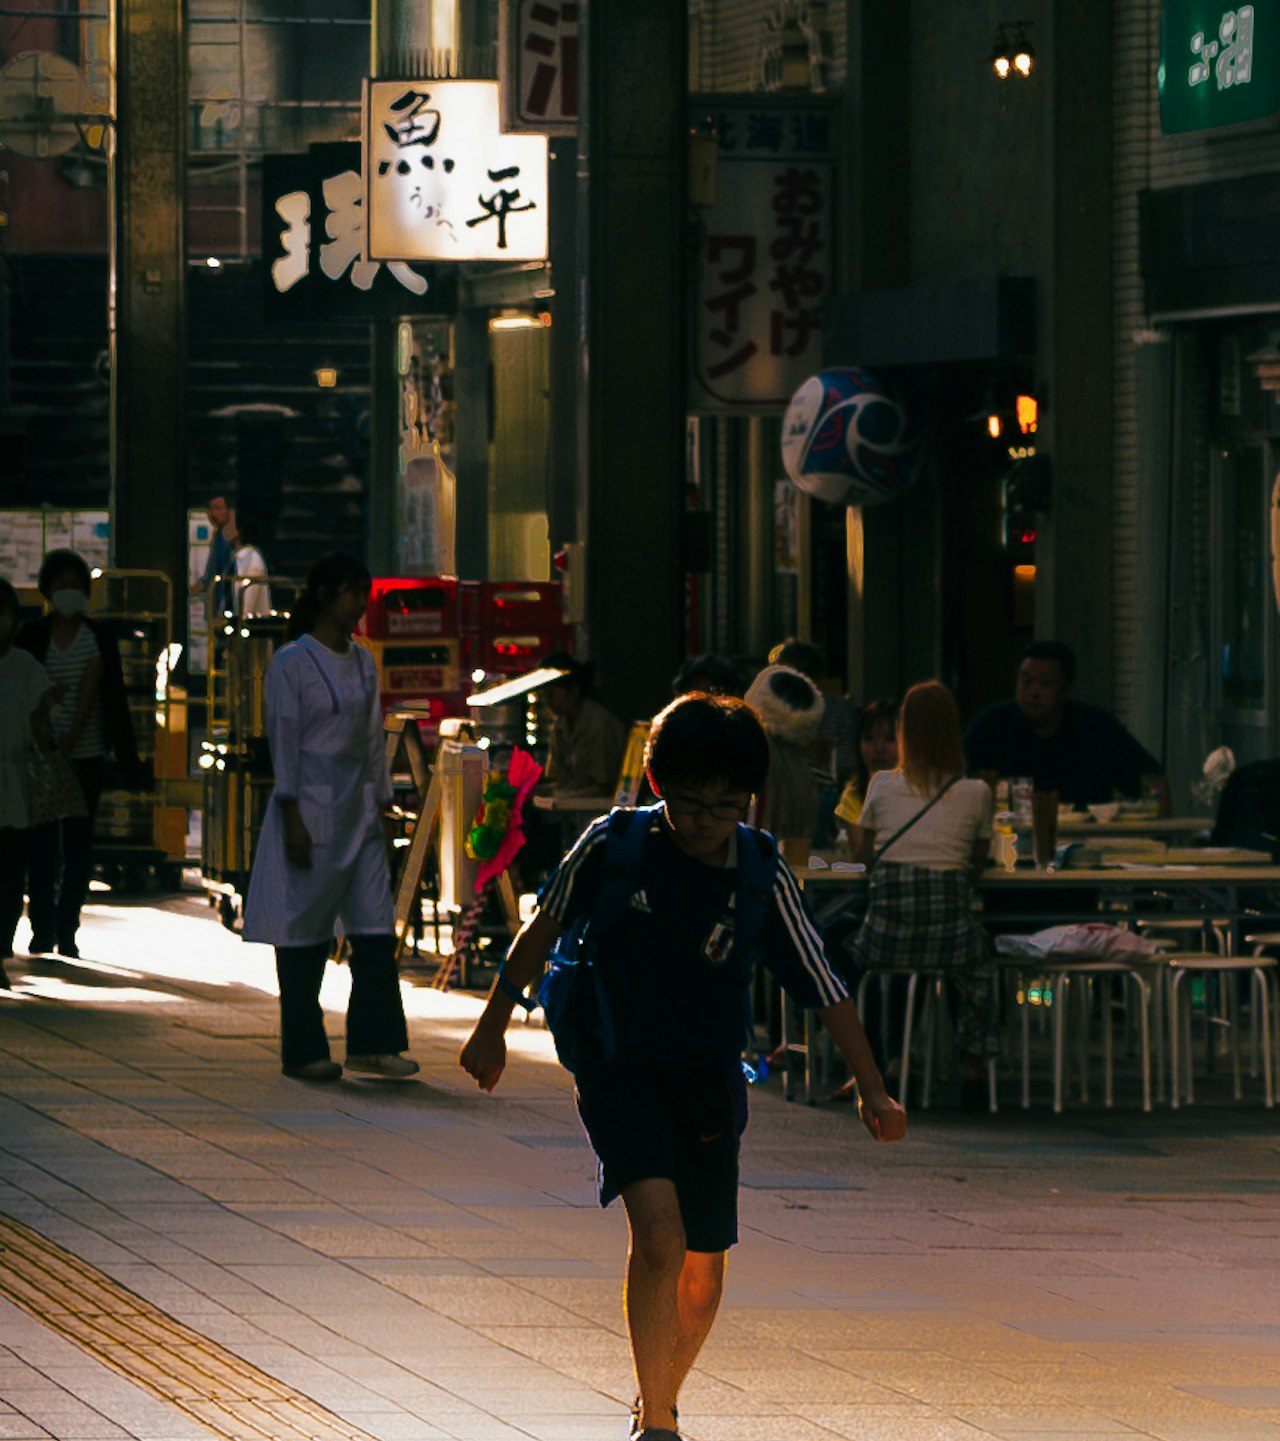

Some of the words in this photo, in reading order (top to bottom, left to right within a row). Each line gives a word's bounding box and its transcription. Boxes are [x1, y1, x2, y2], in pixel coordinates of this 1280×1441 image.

[706, 235, 757, 380] ワイン
[770, 168, 825, 357] おみやげ
